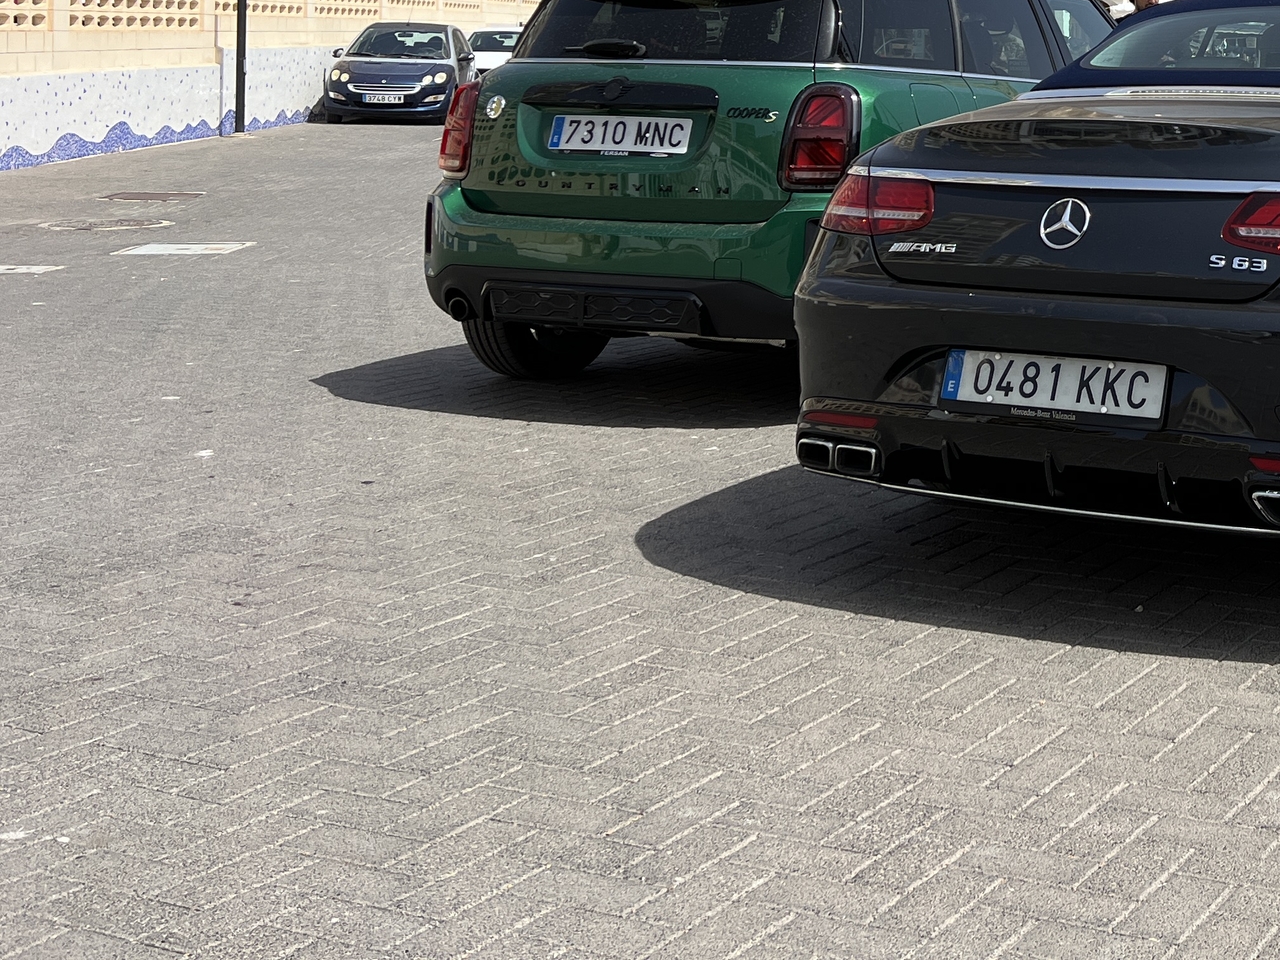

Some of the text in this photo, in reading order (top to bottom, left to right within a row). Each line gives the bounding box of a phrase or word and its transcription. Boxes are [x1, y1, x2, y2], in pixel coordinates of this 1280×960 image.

[565, 120, 685, 147] 7310 MNC
[496, 179, 730, 194] COUNTRYMAN
[910, 242, 957, 254] AMG
[1209, 254, 1267, 272] S 63
[947, 380, 956, 392] E
[973, 358, 1150, 409] 0481 KKC
[1010, 406, 1076, 421] Mercedes-Benz Valencia
